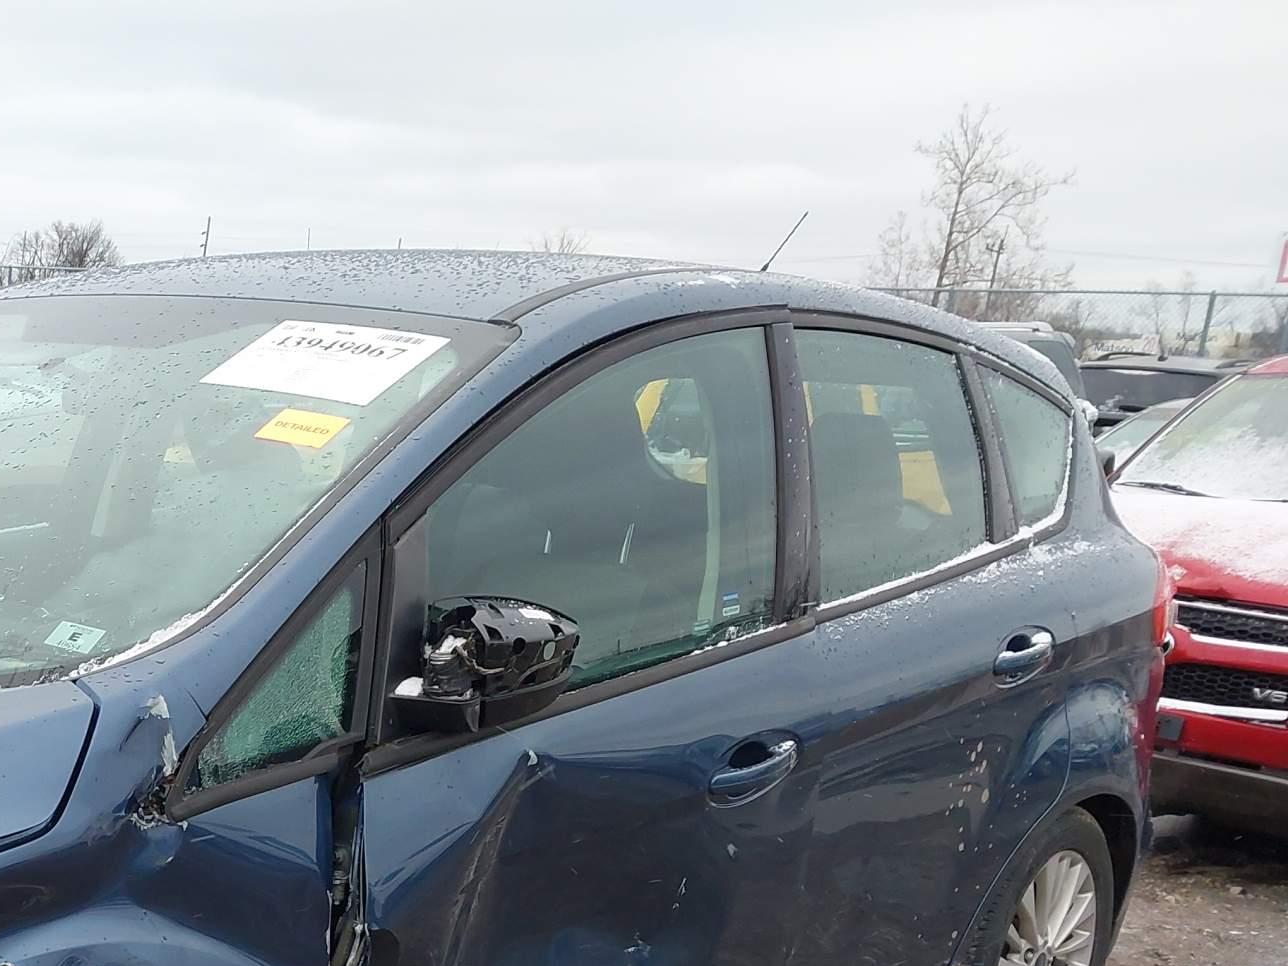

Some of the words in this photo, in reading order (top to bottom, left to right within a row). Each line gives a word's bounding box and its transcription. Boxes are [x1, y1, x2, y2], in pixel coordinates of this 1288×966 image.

[274, 420, 330, 435] DETAILED
[68, 632, 82, 642] E
[1254, 688, 1288, 703] V6
